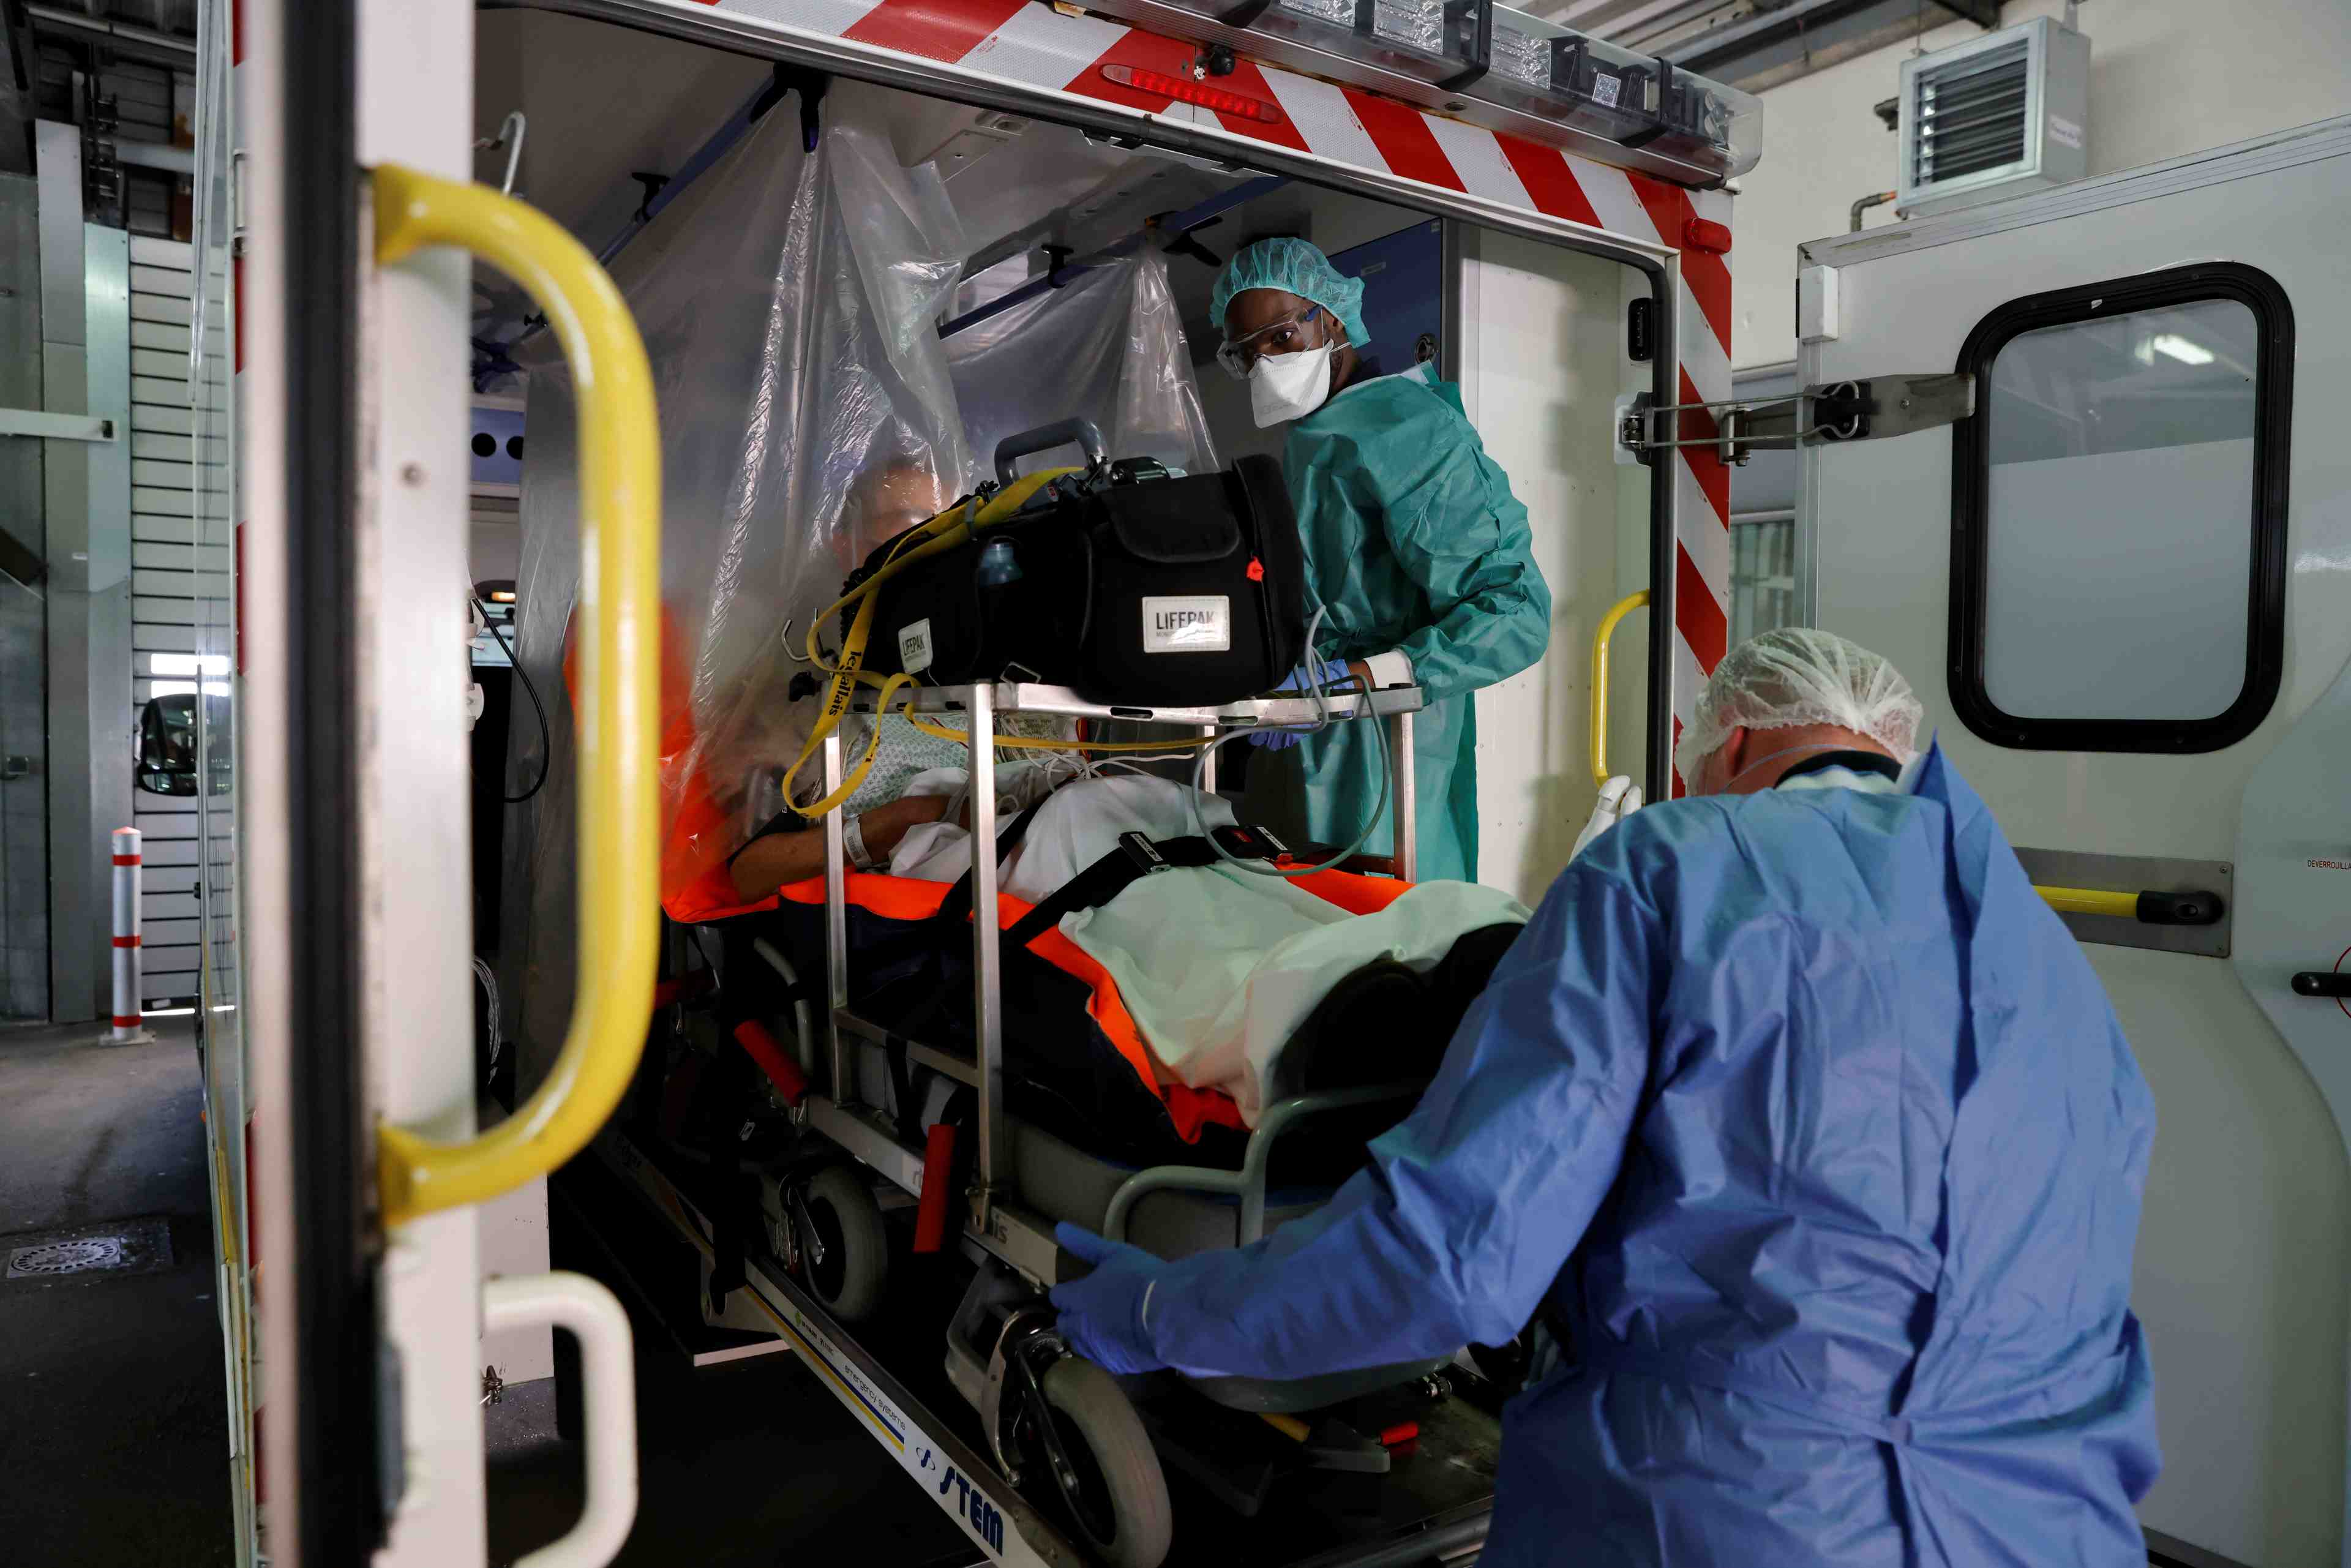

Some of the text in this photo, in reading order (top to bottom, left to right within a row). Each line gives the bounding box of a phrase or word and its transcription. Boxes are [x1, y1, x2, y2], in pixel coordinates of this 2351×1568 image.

[1156, 610, 1215, 630] LIFEPAK
[902, 633, 926, 656] LIFEPAK
[845, 1365, 877, 1402] emergency
